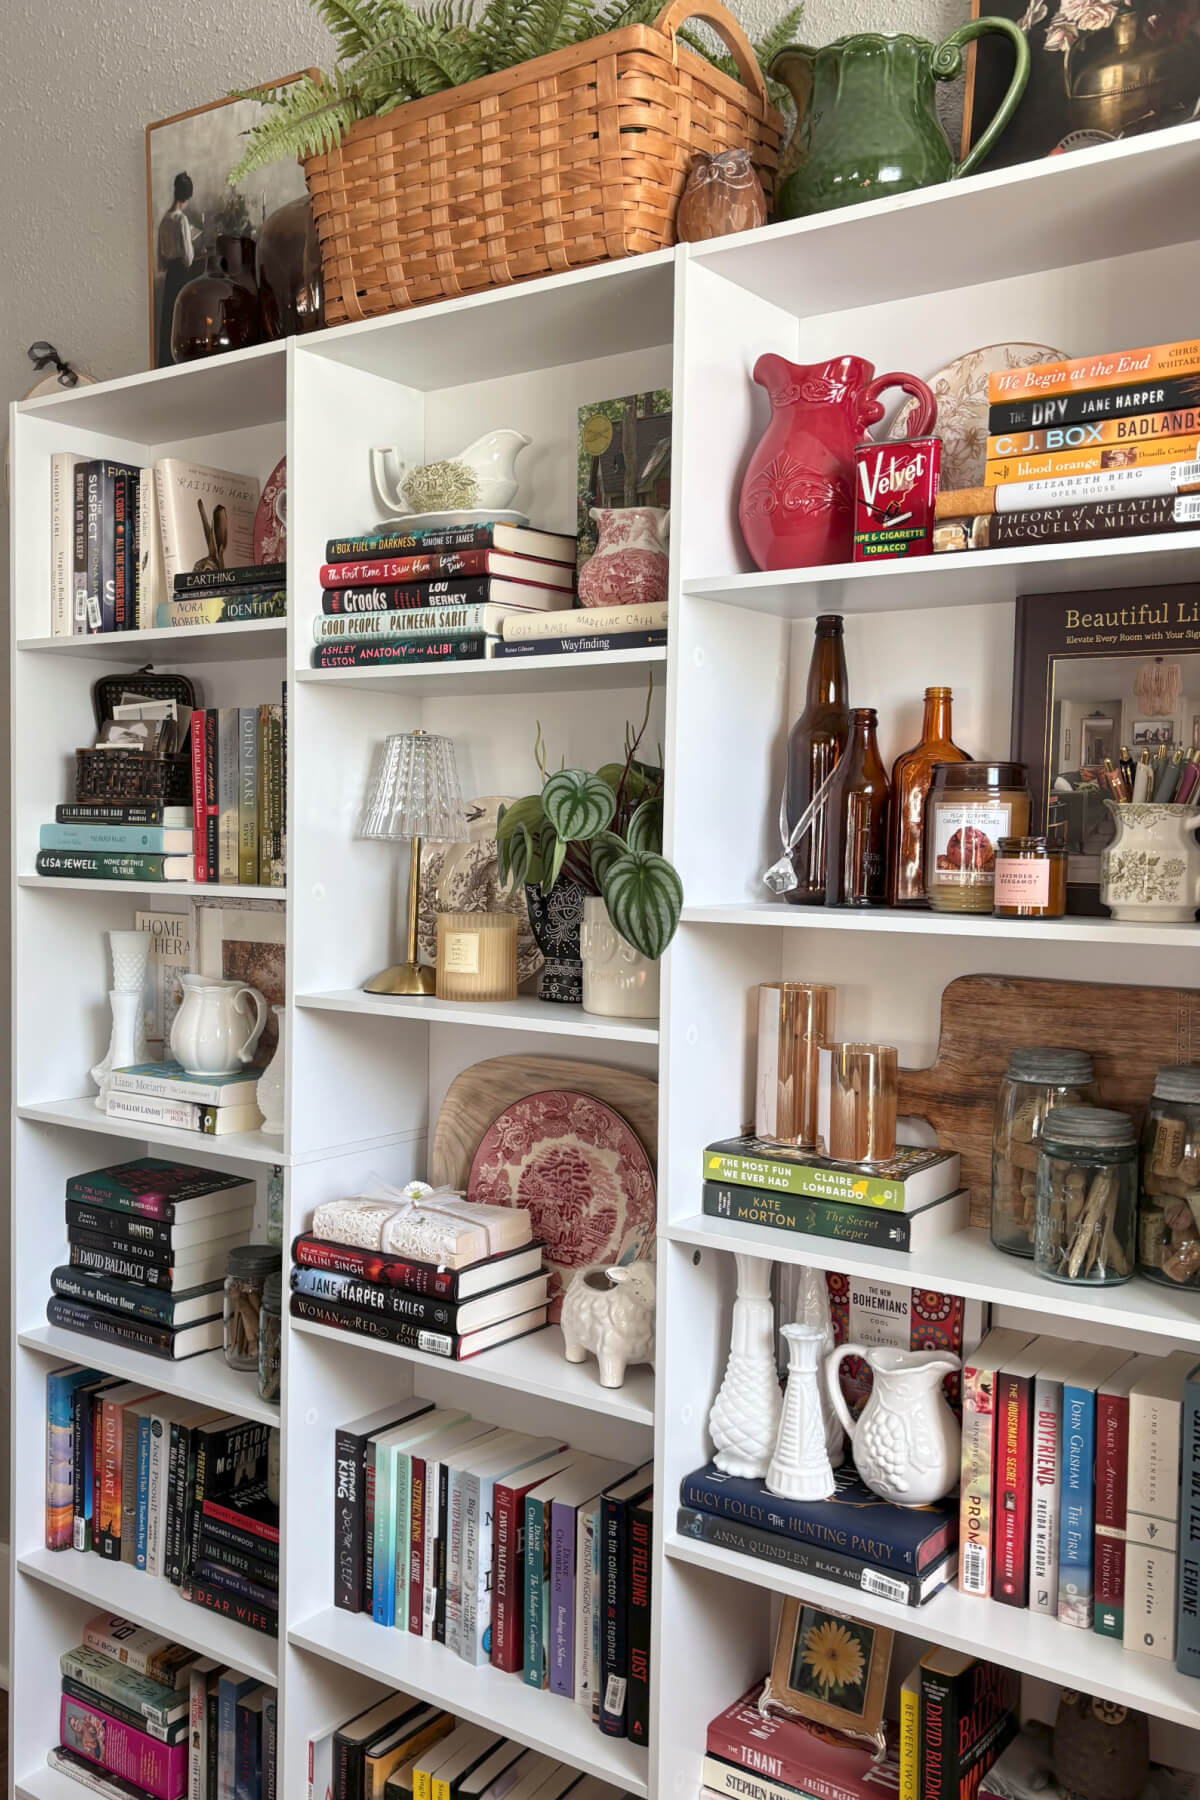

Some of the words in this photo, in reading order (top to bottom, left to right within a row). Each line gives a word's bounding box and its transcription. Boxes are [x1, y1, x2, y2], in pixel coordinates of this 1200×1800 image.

[1168, 344, 1197, 357] CHRIS
[999, 375, 1020, 391] We
[1024, 369, 1066, 387] Begin
[1070, 365, 1085, 376] at
[1090, 361, 1113, 377] the
[1117, 354, 1151, 372] End
[1009, 412, 1027, 424] THE
[1032, 399, 1068, 426] DRY
[1081, 398, 1110, 414] JANE
[1116, 389, 1164, 408] HARPER
[1018, 459, 1052, 476] blood
[1055, 458, 1099, 473] orange
[1028, 476, 1101, 491] ELIZABETH
[1108, 470, 1143, 482] BERG
[858, 451, 927, 517] Velvet
[998, 519, 1096, 540] JACQUELYN
[116, 538, 125, 551] ALL
[336, 542, 351, 554] BOX
[352, 540, 369, 553] FULL
[378, 536, 416, 550] DARKNESS
[422, 535, 444, 547] SIMONE
[445, 535, 454, 545] ST.
[455, 533, 474, 544] JAMES
[865, 543, 907, 554] TOBACCO
[116, 552, 125, 566] THE
[116, 567, 125, 599] SINNERS
[186, 572, 236, 586] EARTHING
[428, 582, 449, 593] LOU
[116, 600, 125, 622] BLEED
[178, 602, 203, 613] NORA
[227, 600, 275, 617] IDENTITY
[343, 588, 388, 612] Crooks
[428, 593, 467, 606] BERNEY
[171, 615, 211, 627] ROBERTS
[321, 620, 345, 635] GOOD
[348, 617, 382, 633] PEOPLE
[390, 612, 436, 630] PATMEENA
[439, 610, 468, 627] SABIT
[1065, 602, 1169, 629] Beautiful
[321, 645, 356, 655] ASHLEY
[360, 646, 407, 659] ANATOMY
[426, 644, 452, 655] ALIBI
[560, 638, 610, 653] Wayfinding
[1066, 635, 1094, 645] Elevate
[1096, 634, 1118, 644] Every
[1119, 633, 1143, 642] Room
[1144, 632, 1163, 641] with
[1165, 631, 1184, 640] Your
[321, 657, 356, 667] ELSTON
[243, 714, 255, 758] JOHN
[243, 765, 254, 808] HART
[41, 857, 61, 869] LISA
[63, 858, 98, 870] JEWELL
[141, 919, 184, 937] HOME
[114, 1076, 134, 1089] Liane
[135, 1079, 168, 1096] Moriarty
[720, 1158, 738, 1168] THE
[741, 1160, 768, 1173] MOST
[771, 1165, 792, 1177] FUN
[723, 1169, 739, 1180] WE
[740, 1172, 765, 1184] EVER
[767, 1175, 789, 1187] HAD
[814, 1172, 853, 1186] CLAIRE
[753, 1196, 781, 1210] KATE
[802, 1182, 864, 1200] LOMBARDO
[737, 1207, 796, 1228] MORTON
[825, 1209, 844, 1223] The
[846, 1213, 879, 1229] Secret
[832, 1225, 869, 1241] Keeper
[112, 1241, 128, 1251] THE
[131, 1245, 154, 1257] ROAD
[80, 1250, 104, 1269] DAVID
[103, 1256, 144, 1280] BALDACCI
[300, 1252, 331, 1268] NALINI
[334, 1260, 364, 1276] SINGH
[310, 1276, 337, 1297] JANE
[340, 1281, 385, 1309] HARPER
[393, 1298, 425, 1318] EXILES
[852, 1292, 908, 1315] BOHEMIANS
[868, 1286, 878, 1295] THE
[879, 1289, 892, 1297] NEW
[298, 1301, 341, 1326] WOMAN
[355, 1316, 377, 1332] RED
[870, 1318, 889, 1327] COOL
[94, 1320, 115, 1333] CHRIS
[116, 1325, 153, 1345] WHITAKER
[1009, 1383, 1019, 1399] THE
[1007, 1401, 1019, 1454] HOUSEMAID'S
[1071, 1399, 1086, 1430] JOHN
[1150, 1407, 1159, 1436] JOHN
[105, 1417, 115, 1454] JOHN
[1005, 1456, 1017, 1489] SECRET
[1069, 1434, 1085, 1489] GRISHAM
[1149, 1441, 1158, 1504] STEINBECK
[104, 1459, 114, 1497] HART
[151, 1470, 159, 1512] Picoult
[337, 1459, 350, 1499] KING
[348, 1459, 356, 1503] STEPHEN
[412, 1478, 422, 1518] STEPHEN
[451, 1489, 462, 1519] DAVID
[466, 1498, 476, 1516] Big
[498, 1509, 508, 1543] DAVID
[688, 1487, 721, 1508] LUCY
[724, 1497, 765, 1521] FOLEY
[768, 1513, 785, 1528] THE
[788, 1517, 847, 1546] HUNTING
[851, 1535, 894, 1560] PARTY
[1036, 1498, 1047, 1529] FREIDA
[1068, 1505, 1083, 1527] THE
[204, 1522, 231, 1538] MARGARET
[231, 1534, 254, 1549] ATWOOD
[341, 1508, 353, 1548] DOCTOR
[412, 1519, 421, 1542] KING
[466, 1517, 476, 1546] Little
[527, 1506, 537, 1567] CHAMBERLAIN
[534, 1524, 542, 1552] DIANE
[632, 1520, 648, 1543] JOY
[451, 1519, 462, 1565] BALDACCI
[713, 1529, 746, 1547] ANNA
[749, 1539, 809, 1567] QUINDLEN
[815, 1561, 841, 1576] BLACK
[843, 1568, 861, 1580] AND
[1035, 1533, 1047, 1578] McFADDEN
[1067, 1531, 1082, 1560] FIRM
[205, 1543, 220, 1558] JANE
[222, 1550, 249, 1570] HARPER
[340, 1550, 353, 1590] SLEEP
[411, 1549, 421, 1584] CARRIE
[466, 1548, 475, 1571] Lies
[497, 1544, 507, 1596] BALDACCI
[555, 1528, 565, 1593] CHAMBERLAIN
[583, 1538, 593, 1577] KRISTAN
[632, 1546, 648, 1608] FIELDING
[1101, 1542, 1113, 1599] HENDRICKS
[582, 1579, 592, 1615] HIGGINS
[1182, 1558, 1199, 1617] LEHANE
[197, 1590, 230, 1612] DEAR
[236, 1604, 267, 1630] WIFE
[101, 1641, 118, 1656] BOX
[631, 1648, 648, 1683] LOST
[904, 1703, 914, 1758] BETWEEN
[925, 1701, 944, 1748] DAVID
[727, 1744, 738, 1754] THE
[740, 1745, 784, 1778] TENANT
[725, 1774, 768, 1800] STEPHEN
[803, 1777, 830, 1796] FREIDA
[903, 1763, 914, 1791] TWO
